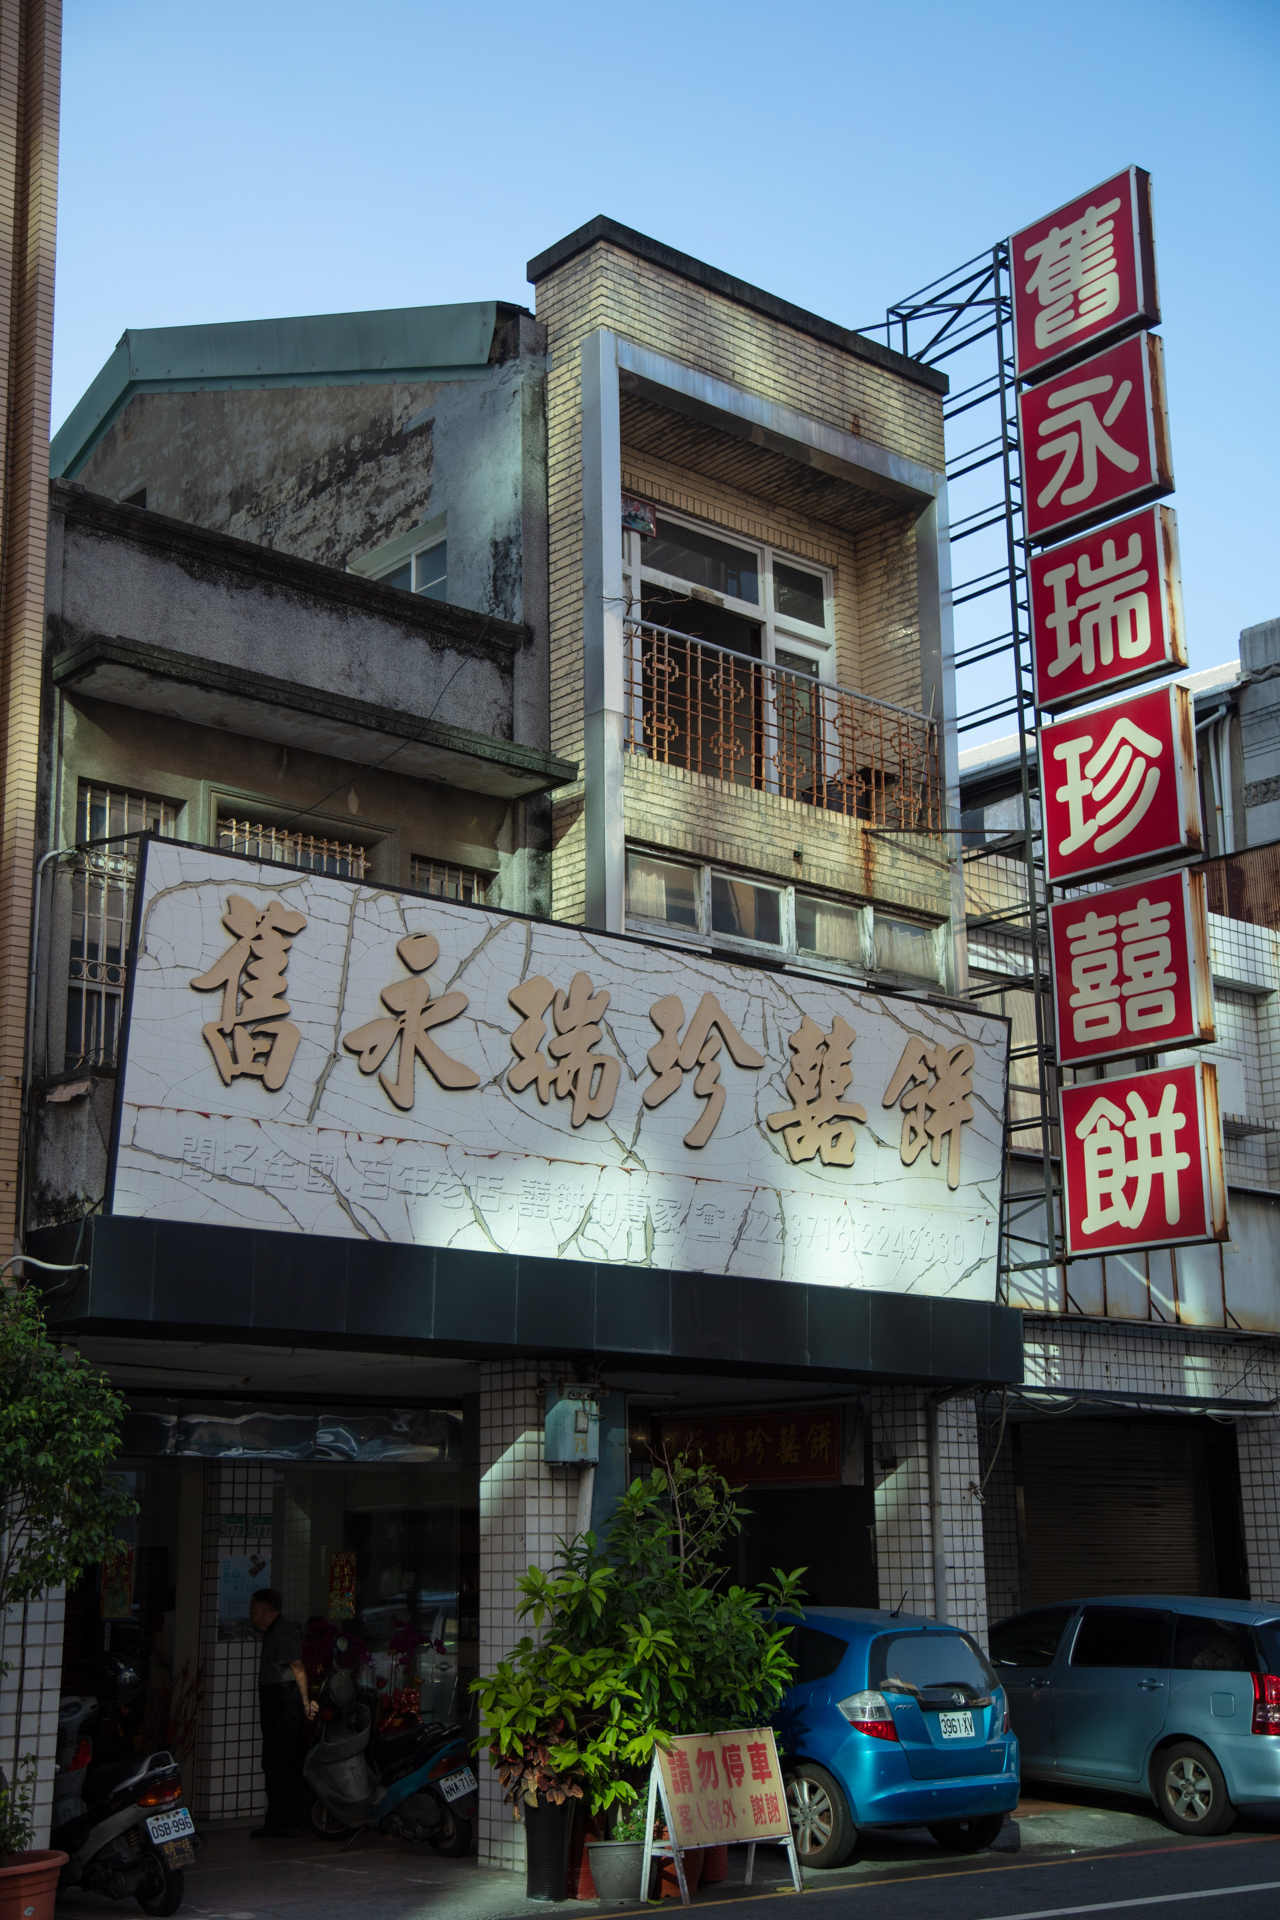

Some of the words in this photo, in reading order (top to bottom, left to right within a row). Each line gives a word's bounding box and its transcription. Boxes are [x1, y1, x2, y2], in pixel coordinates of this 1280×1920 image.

[1024, 197, 1191, 1236] 舊永瑞珍囍餅
[190, 895, 975, 1190] 舊永瑞珍囍餅
[574, 1438, 588, 1453] 75
[228, 1525, 244, 1536] 179
[255, 1526, 270, 1537] 181
[667, 1742, 773, 1795] 請勿停車
